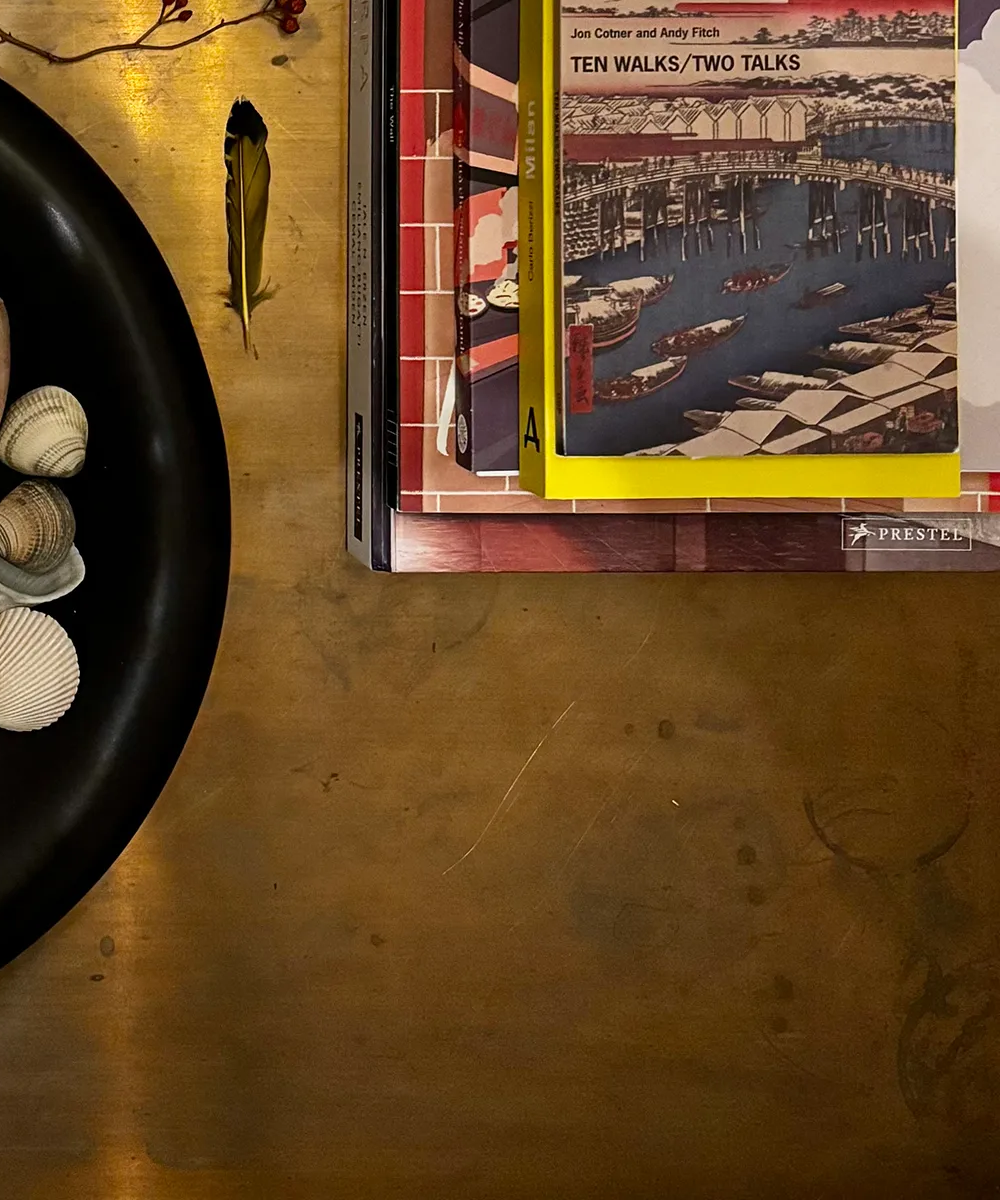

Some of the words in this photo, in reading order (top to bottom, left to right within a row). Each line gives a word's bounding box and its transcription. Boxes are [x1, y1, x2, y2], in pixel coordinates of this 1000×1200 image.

[570, 28, 591, 39] Jon
[595, 28, 631, 39] Cotner
[636, 27, 656, 38] and
[660, 27, 688, 40] Andy
[692, 27, 720, 38] Fitch
[571, 56, 608, 73] TEN
[614, 53, 735, 74] WALKS/TWO
[741, 54, 801, 71] TALKS
[524, 100, 536, 180] Milan
[879, 527, 963, 541] PRESTEL
